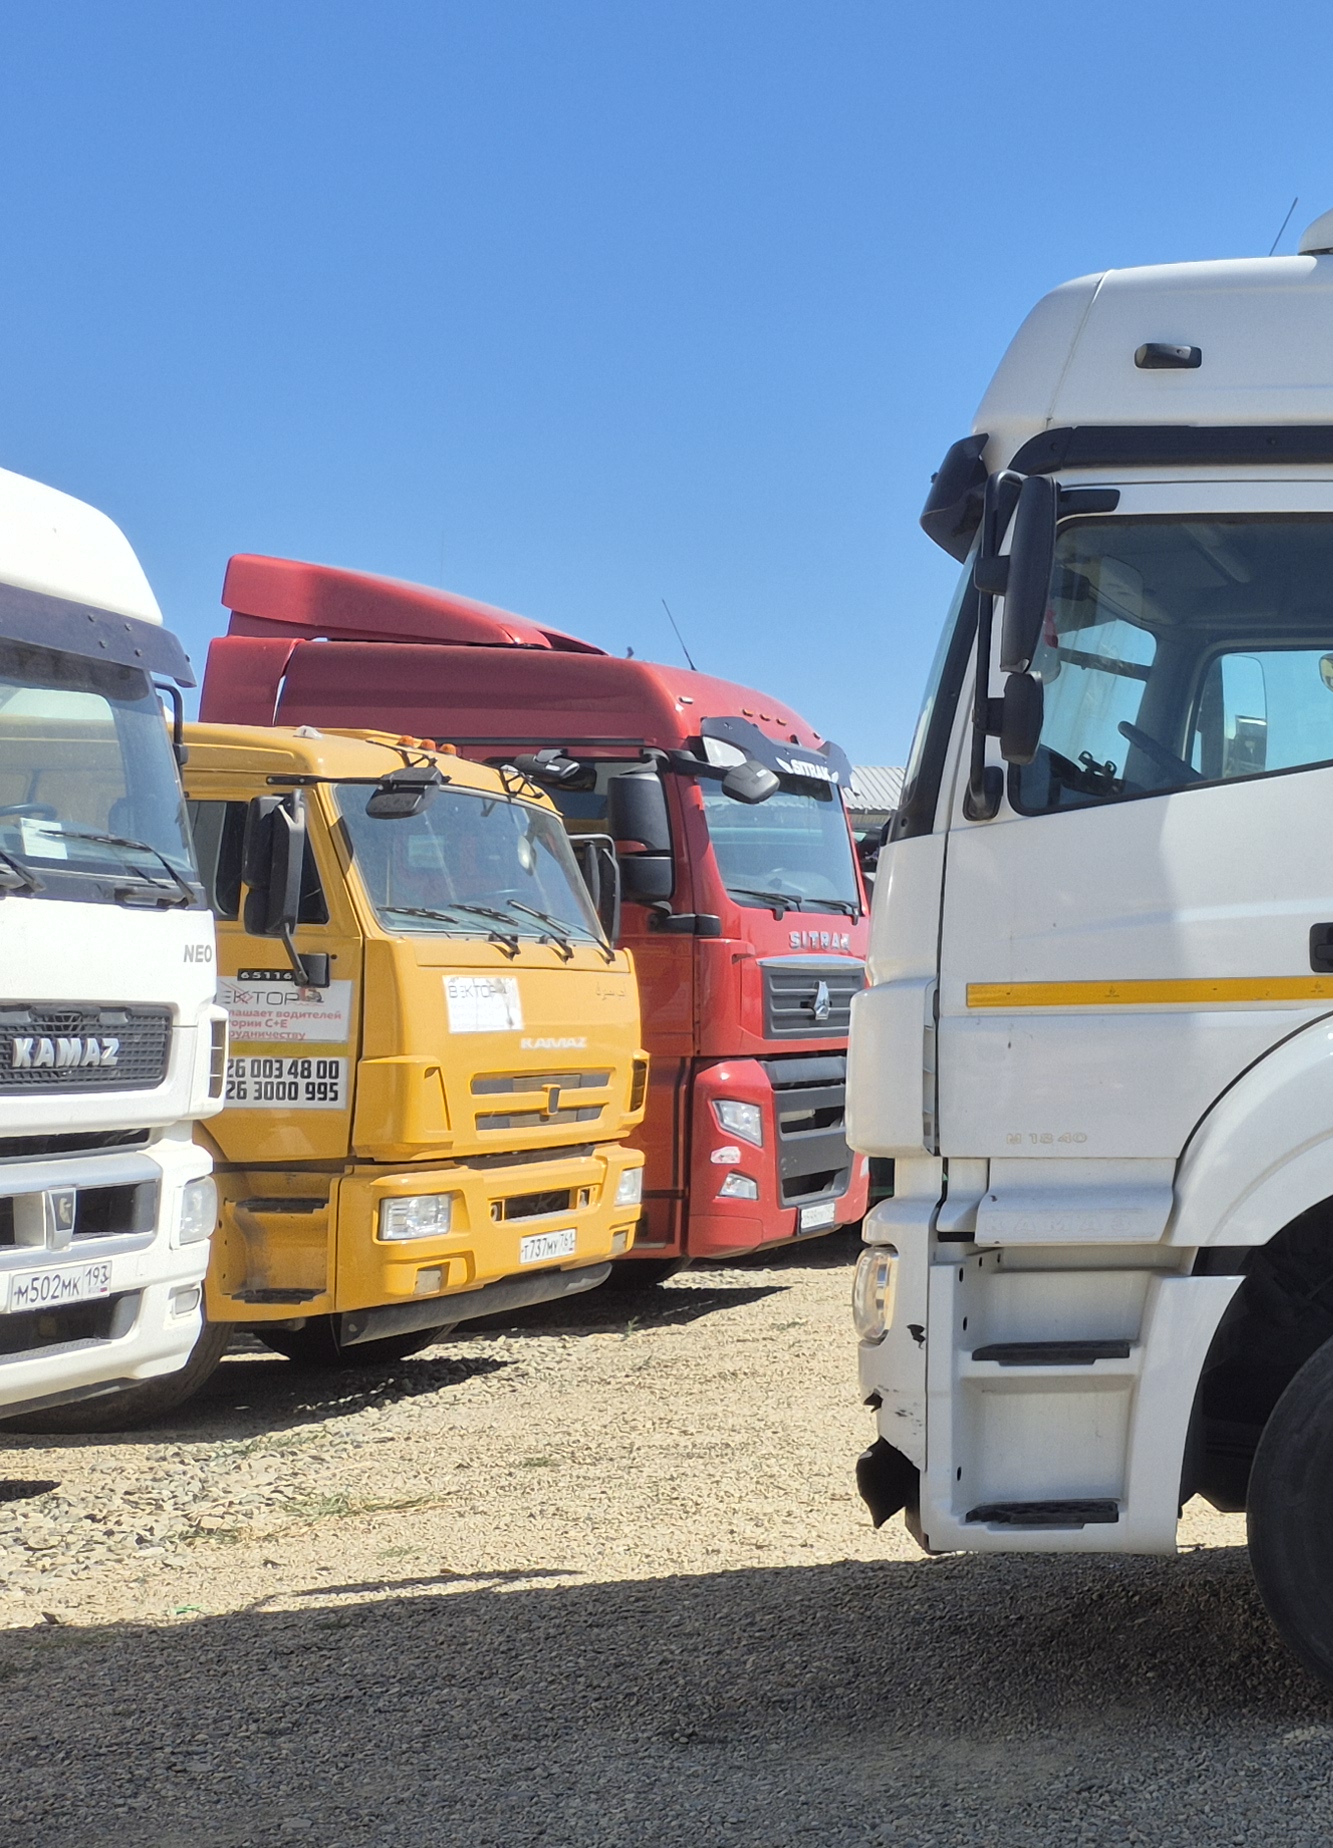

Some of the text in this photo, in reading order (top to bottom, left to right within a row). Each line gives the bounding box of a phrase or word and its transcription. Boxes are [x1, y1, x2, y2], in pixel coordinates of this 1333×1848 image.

[790, 758, 831, 781] SITRAK
[183, 944, 212, 962] NEO
[240, 971, 293, 980] 65116
[276, 1010, 342, 1020] водителей
[12, 1037, 120, 1068] KAMAZ
[520, 1037, 588, 1050] KAMAZ
[250, 1058, 283, 1079] 003
[287, 1059, 312, 1080] 48
[316, 1060, 340, 1080] 00
[225, 1080, 339, 1102] 26 3000 995
[85, 1265, 109, 1287] 193
